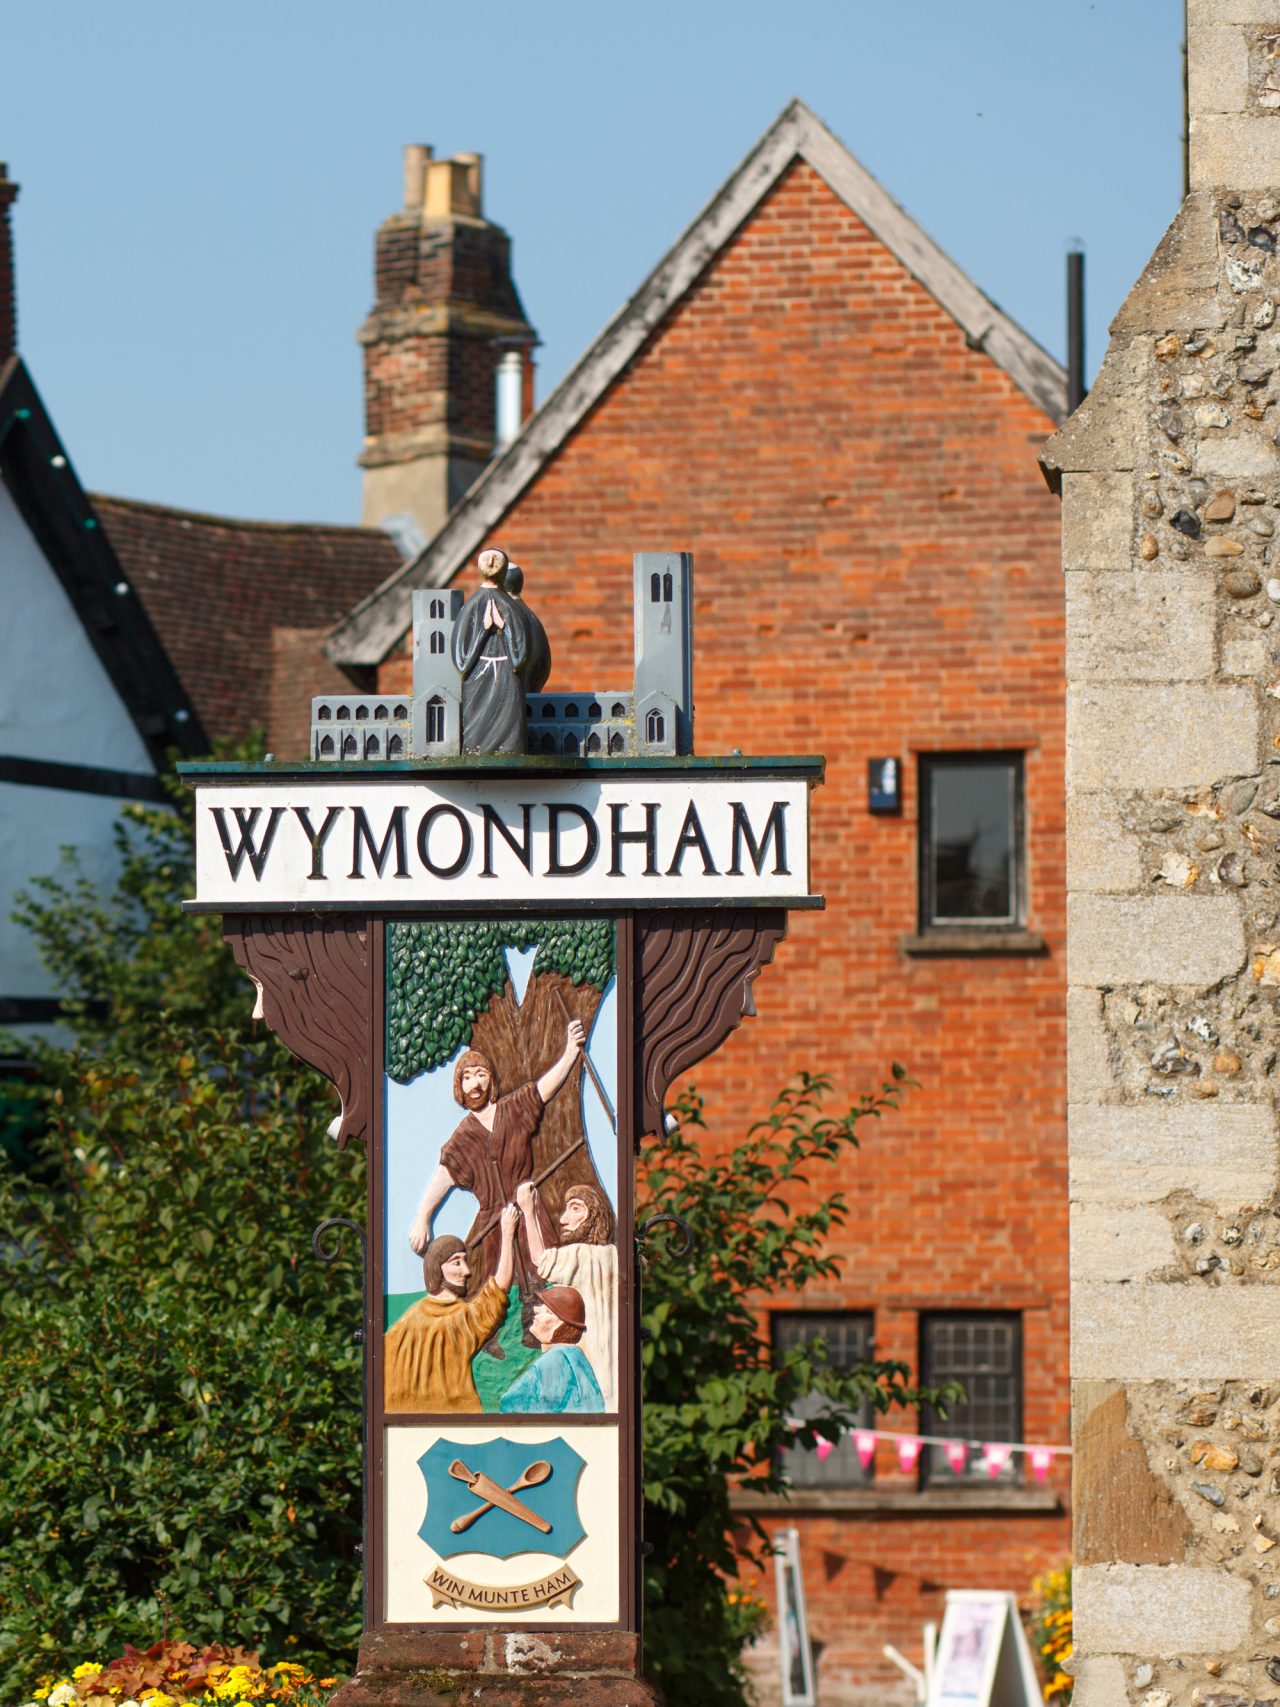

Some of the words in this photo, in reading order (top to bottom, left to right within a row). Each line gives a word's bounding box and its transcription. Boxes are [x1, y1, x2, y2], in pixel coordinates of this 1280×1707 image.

[208, 799, 792, 882] WYMONDHAM
[432, 1570, 465, 1596] WIN
[468, 1588, 530, 1604] MUNTE
[534, 1572, 571, 1598] HAM
